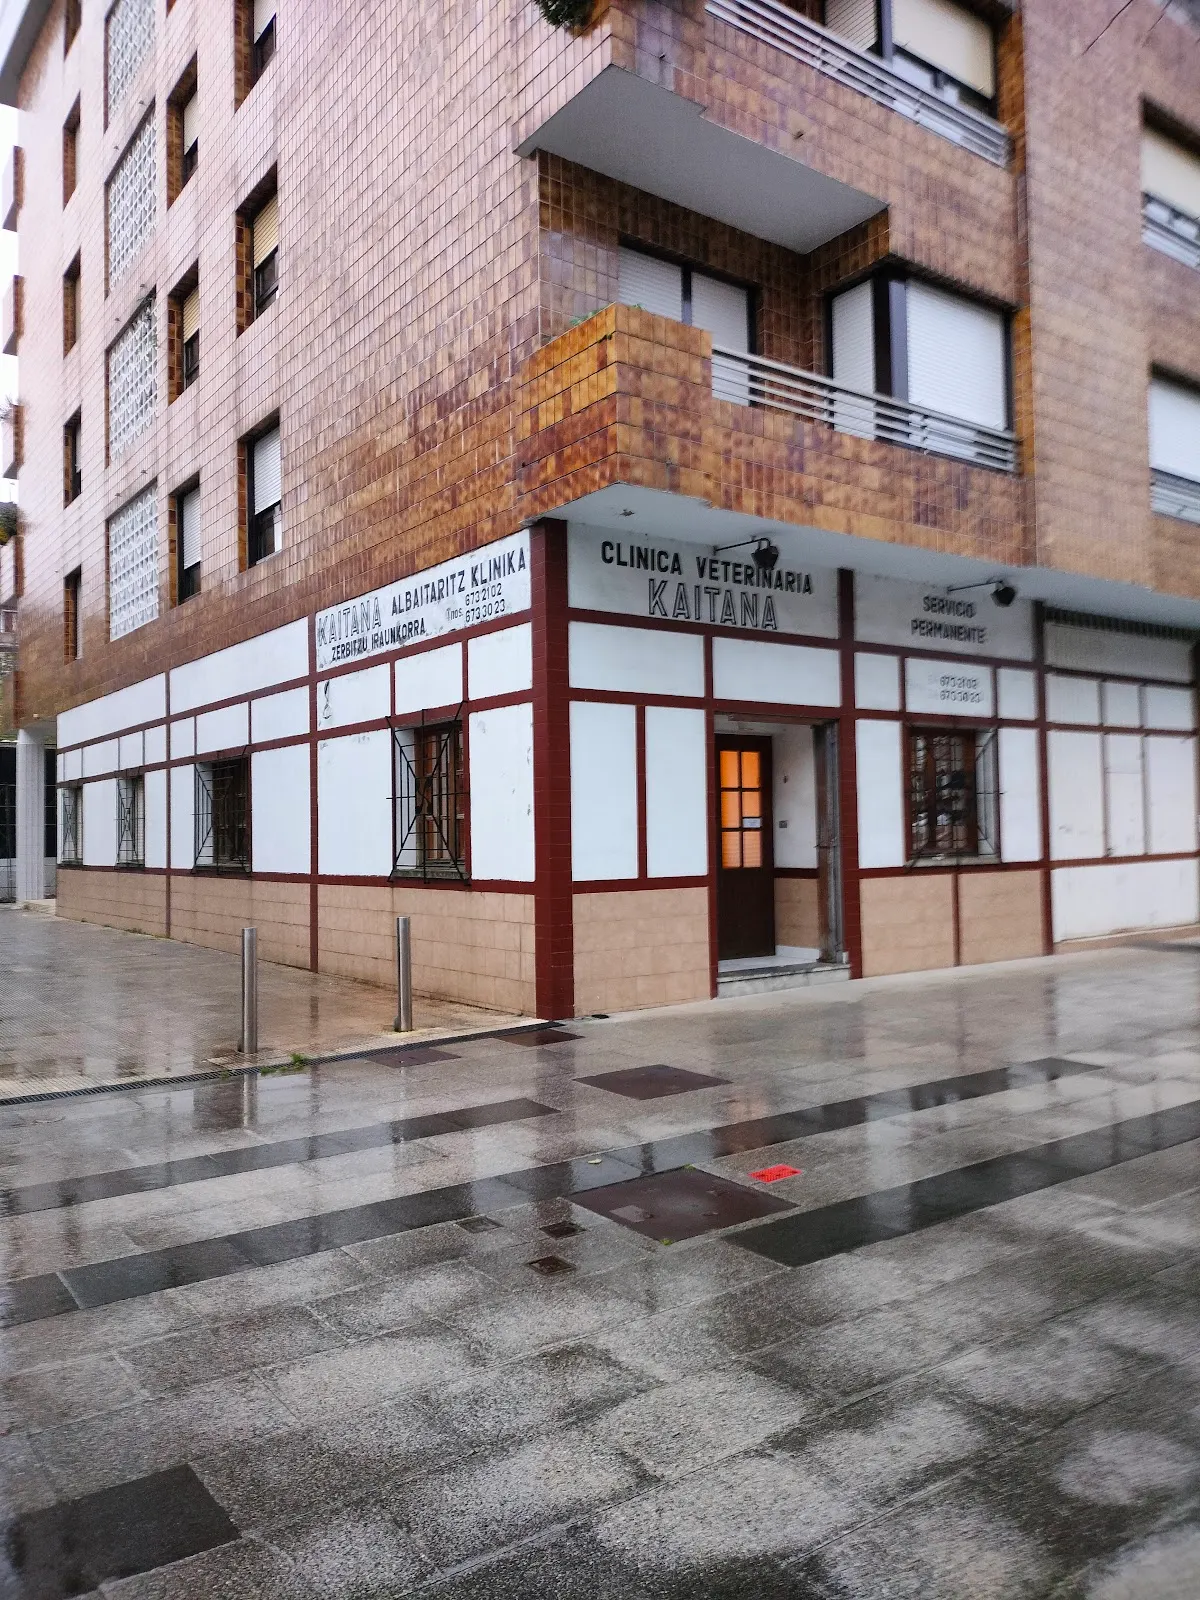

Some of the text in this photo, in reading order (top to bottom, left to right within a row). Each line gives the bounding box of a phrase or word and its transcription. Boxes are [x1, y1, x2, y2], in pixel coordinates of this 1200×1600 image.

[601, 540, 813, 595] CLINICA VETERINARIA
[317, 546, 527, 648] KAITANA ALBAITARITZ KLINIKA
[648, 578, 778, 631] KAITANA
[923, 595, 977, 619] SERVICIO
[331, 617, 426, 662] ZERBITZU IRAUNKORRA
[911, 619, 987, 644] PERMANENTE
